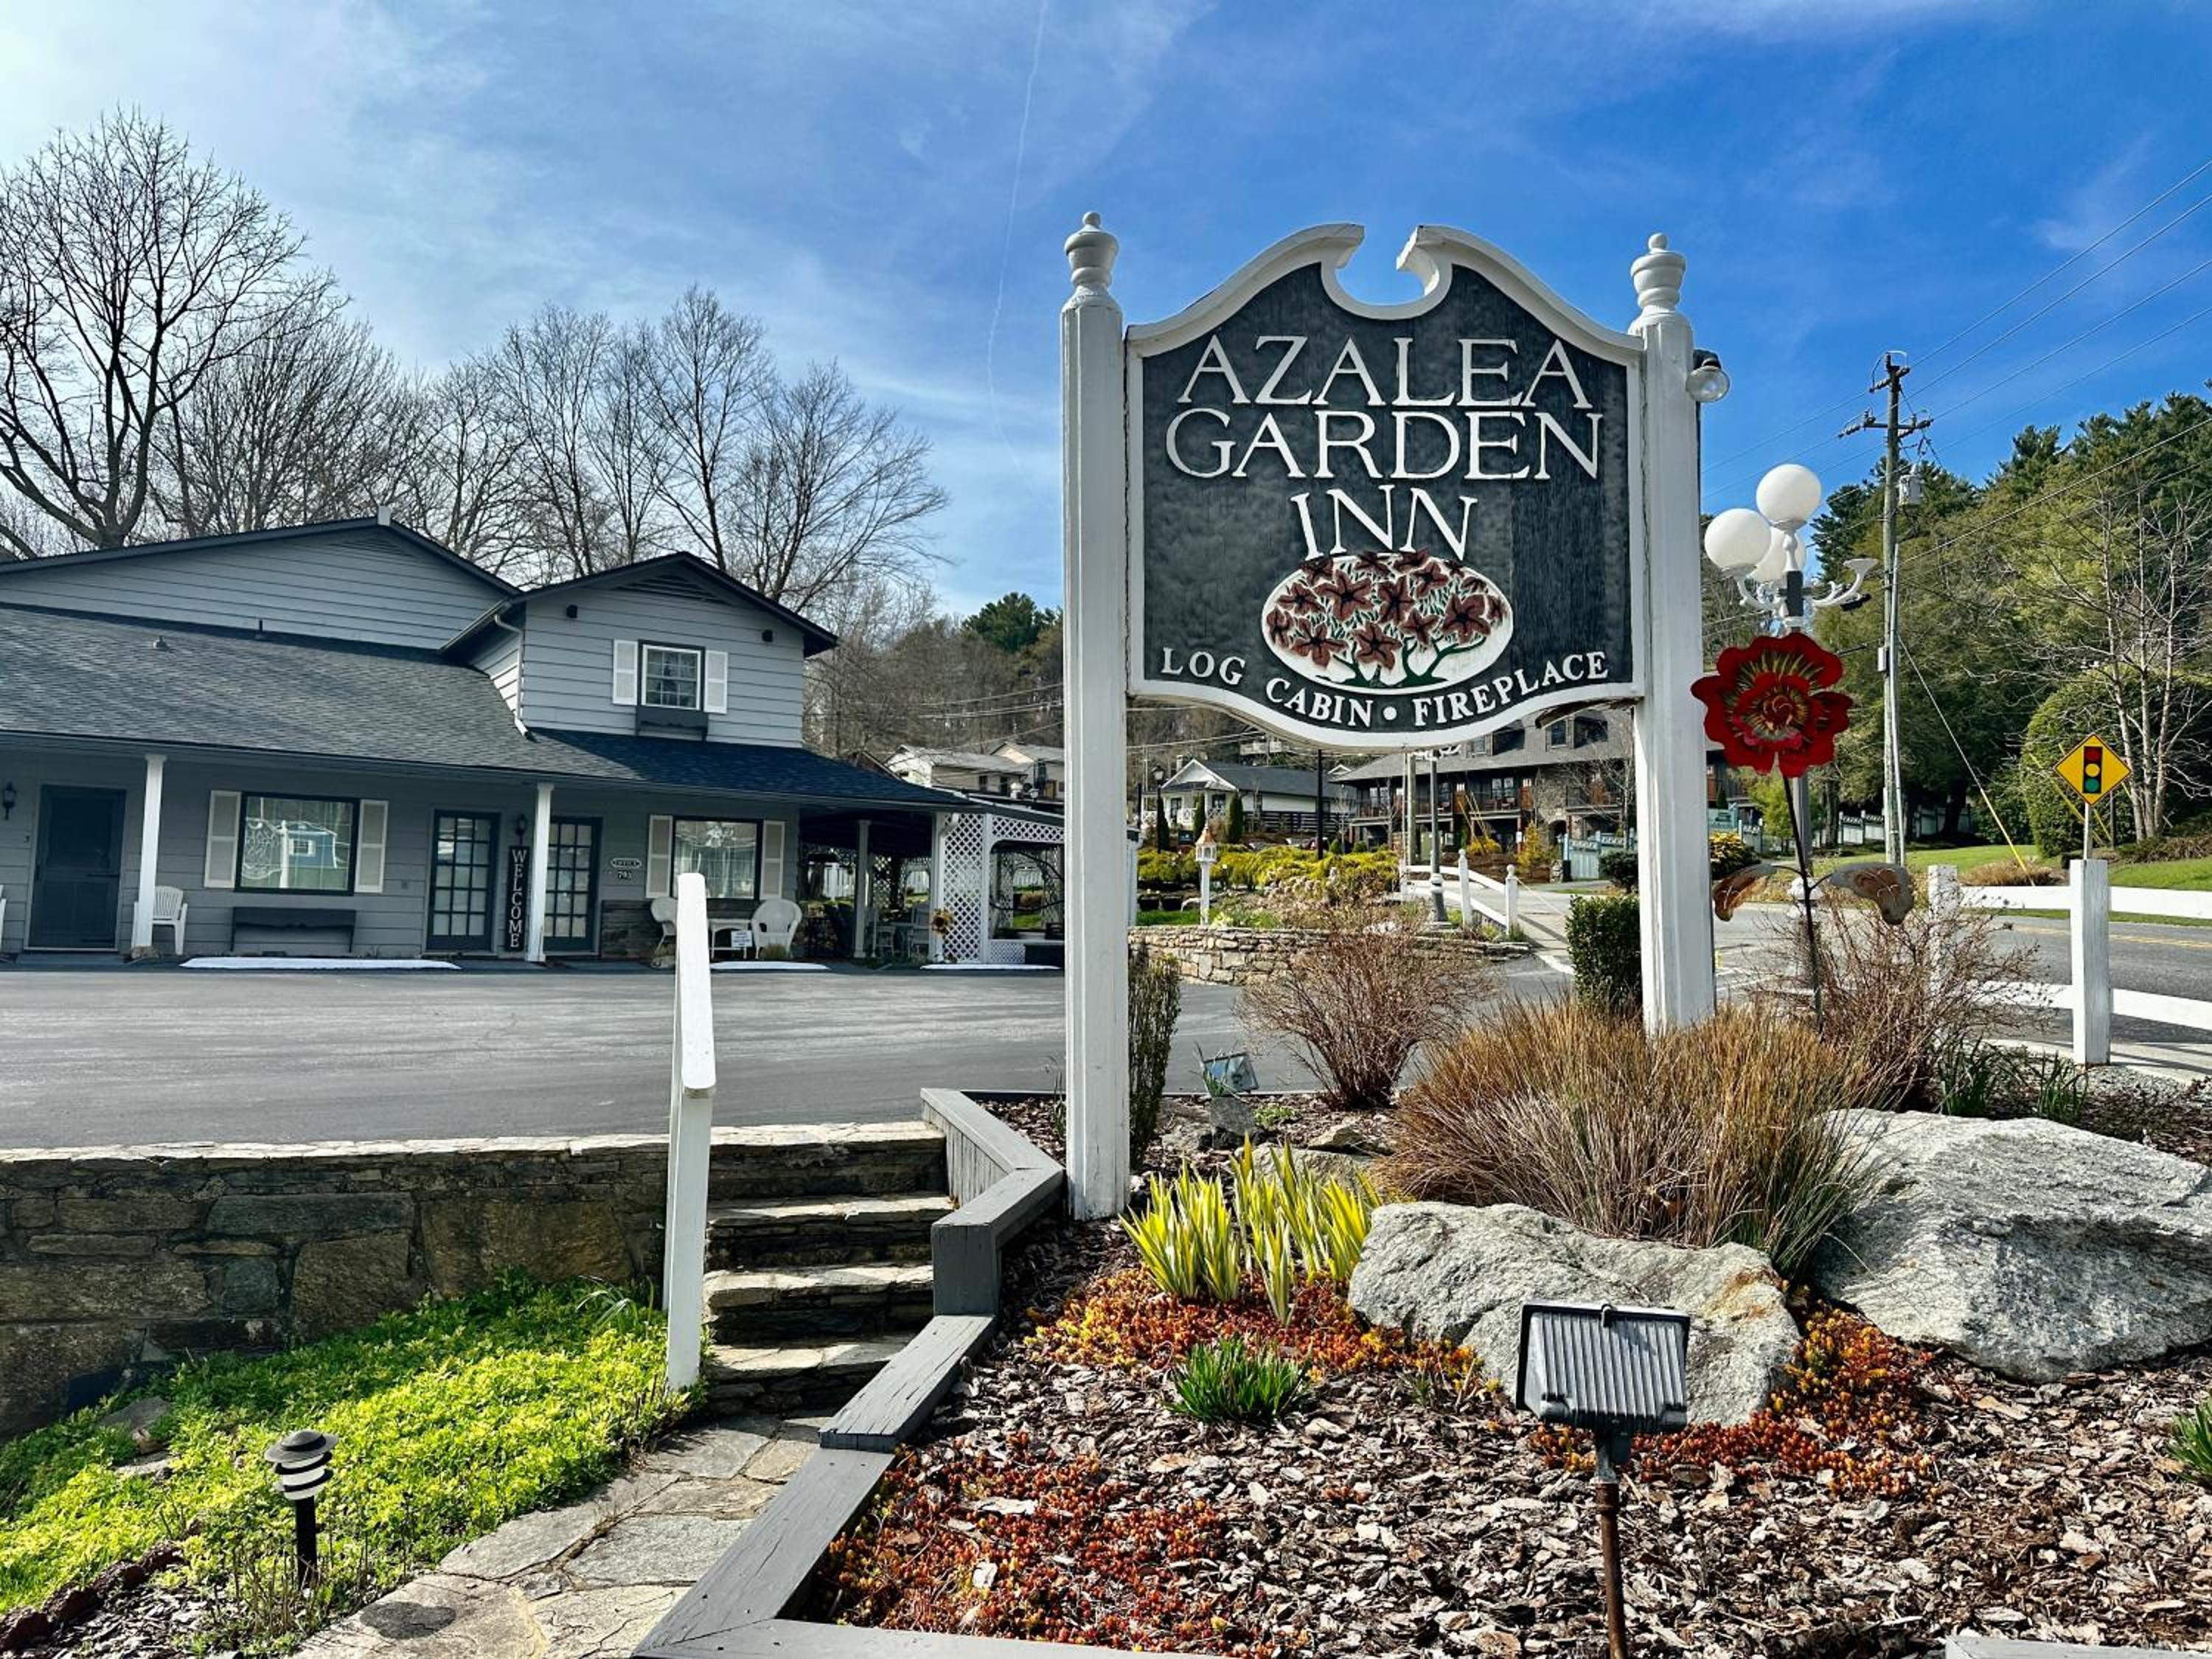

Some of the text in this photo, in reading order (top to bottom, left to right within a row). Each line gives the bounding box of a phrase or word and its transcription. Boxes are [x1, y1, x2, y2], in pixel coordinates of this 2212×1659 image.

[1176, 333, 1593, 409] AZALEA
[1165, 407, 1604, 479] GARDEN
[1290, 484, 1478, 560] INN
[1161, 646, 1609, 728] LOG CABIN FIREPLACE
[508, 849, 528, 948] WELCOME
